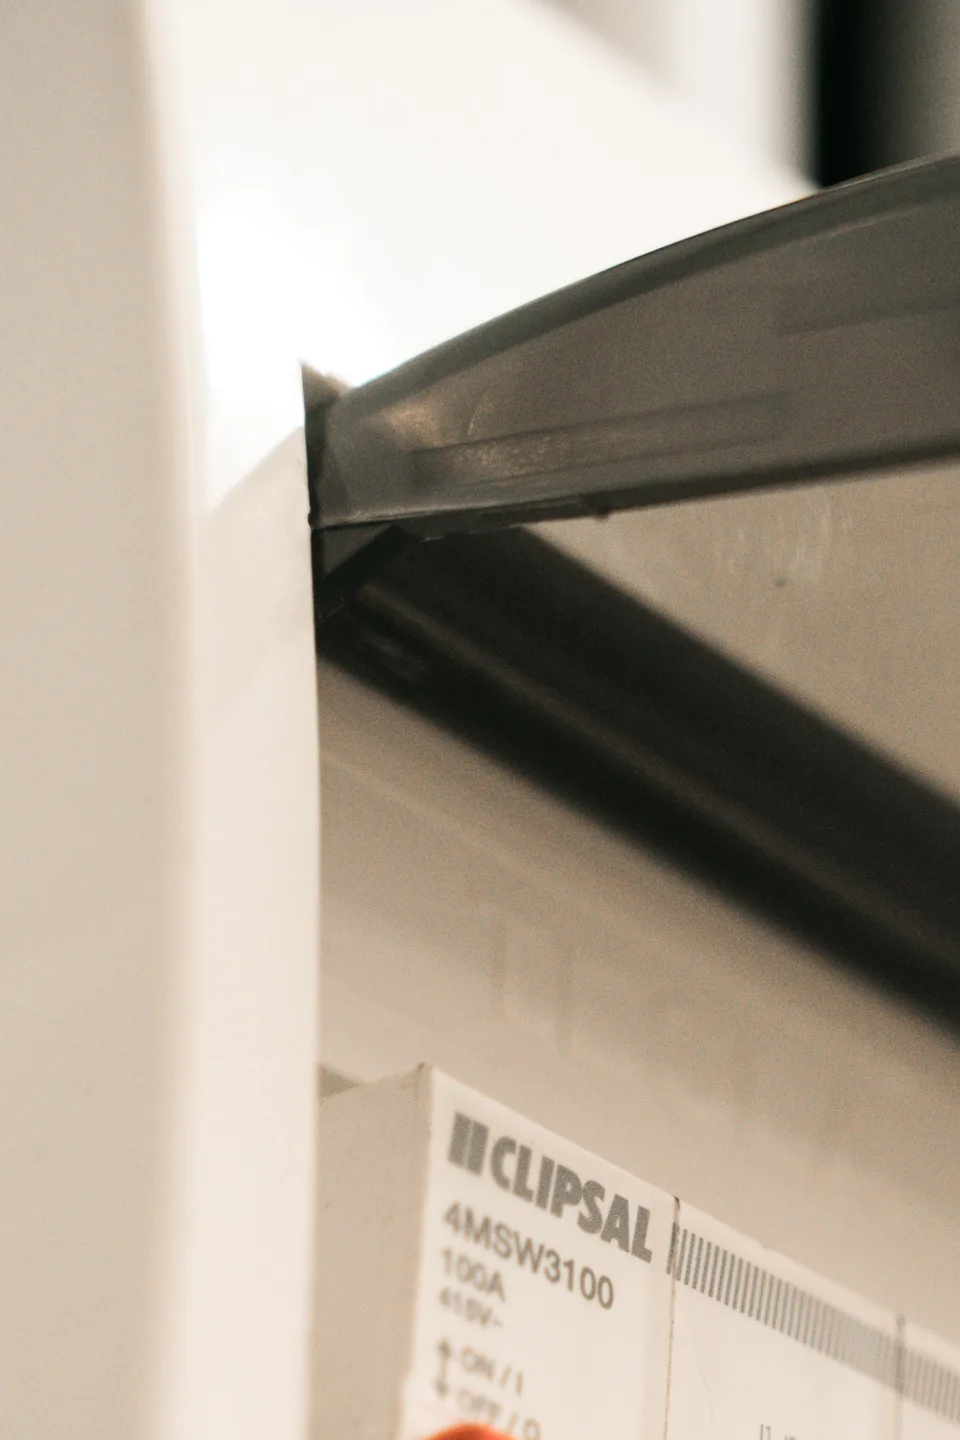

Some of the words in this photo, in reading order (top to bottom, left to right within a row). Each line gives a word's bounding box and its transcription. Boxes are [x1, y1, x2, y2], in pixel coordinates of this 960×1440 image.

[491, 1136, 653, 1264] CLIPSAL
[442, 1248, 506, 1303] 100A
[443, 1201, 615, 1310] 4MSW3100
